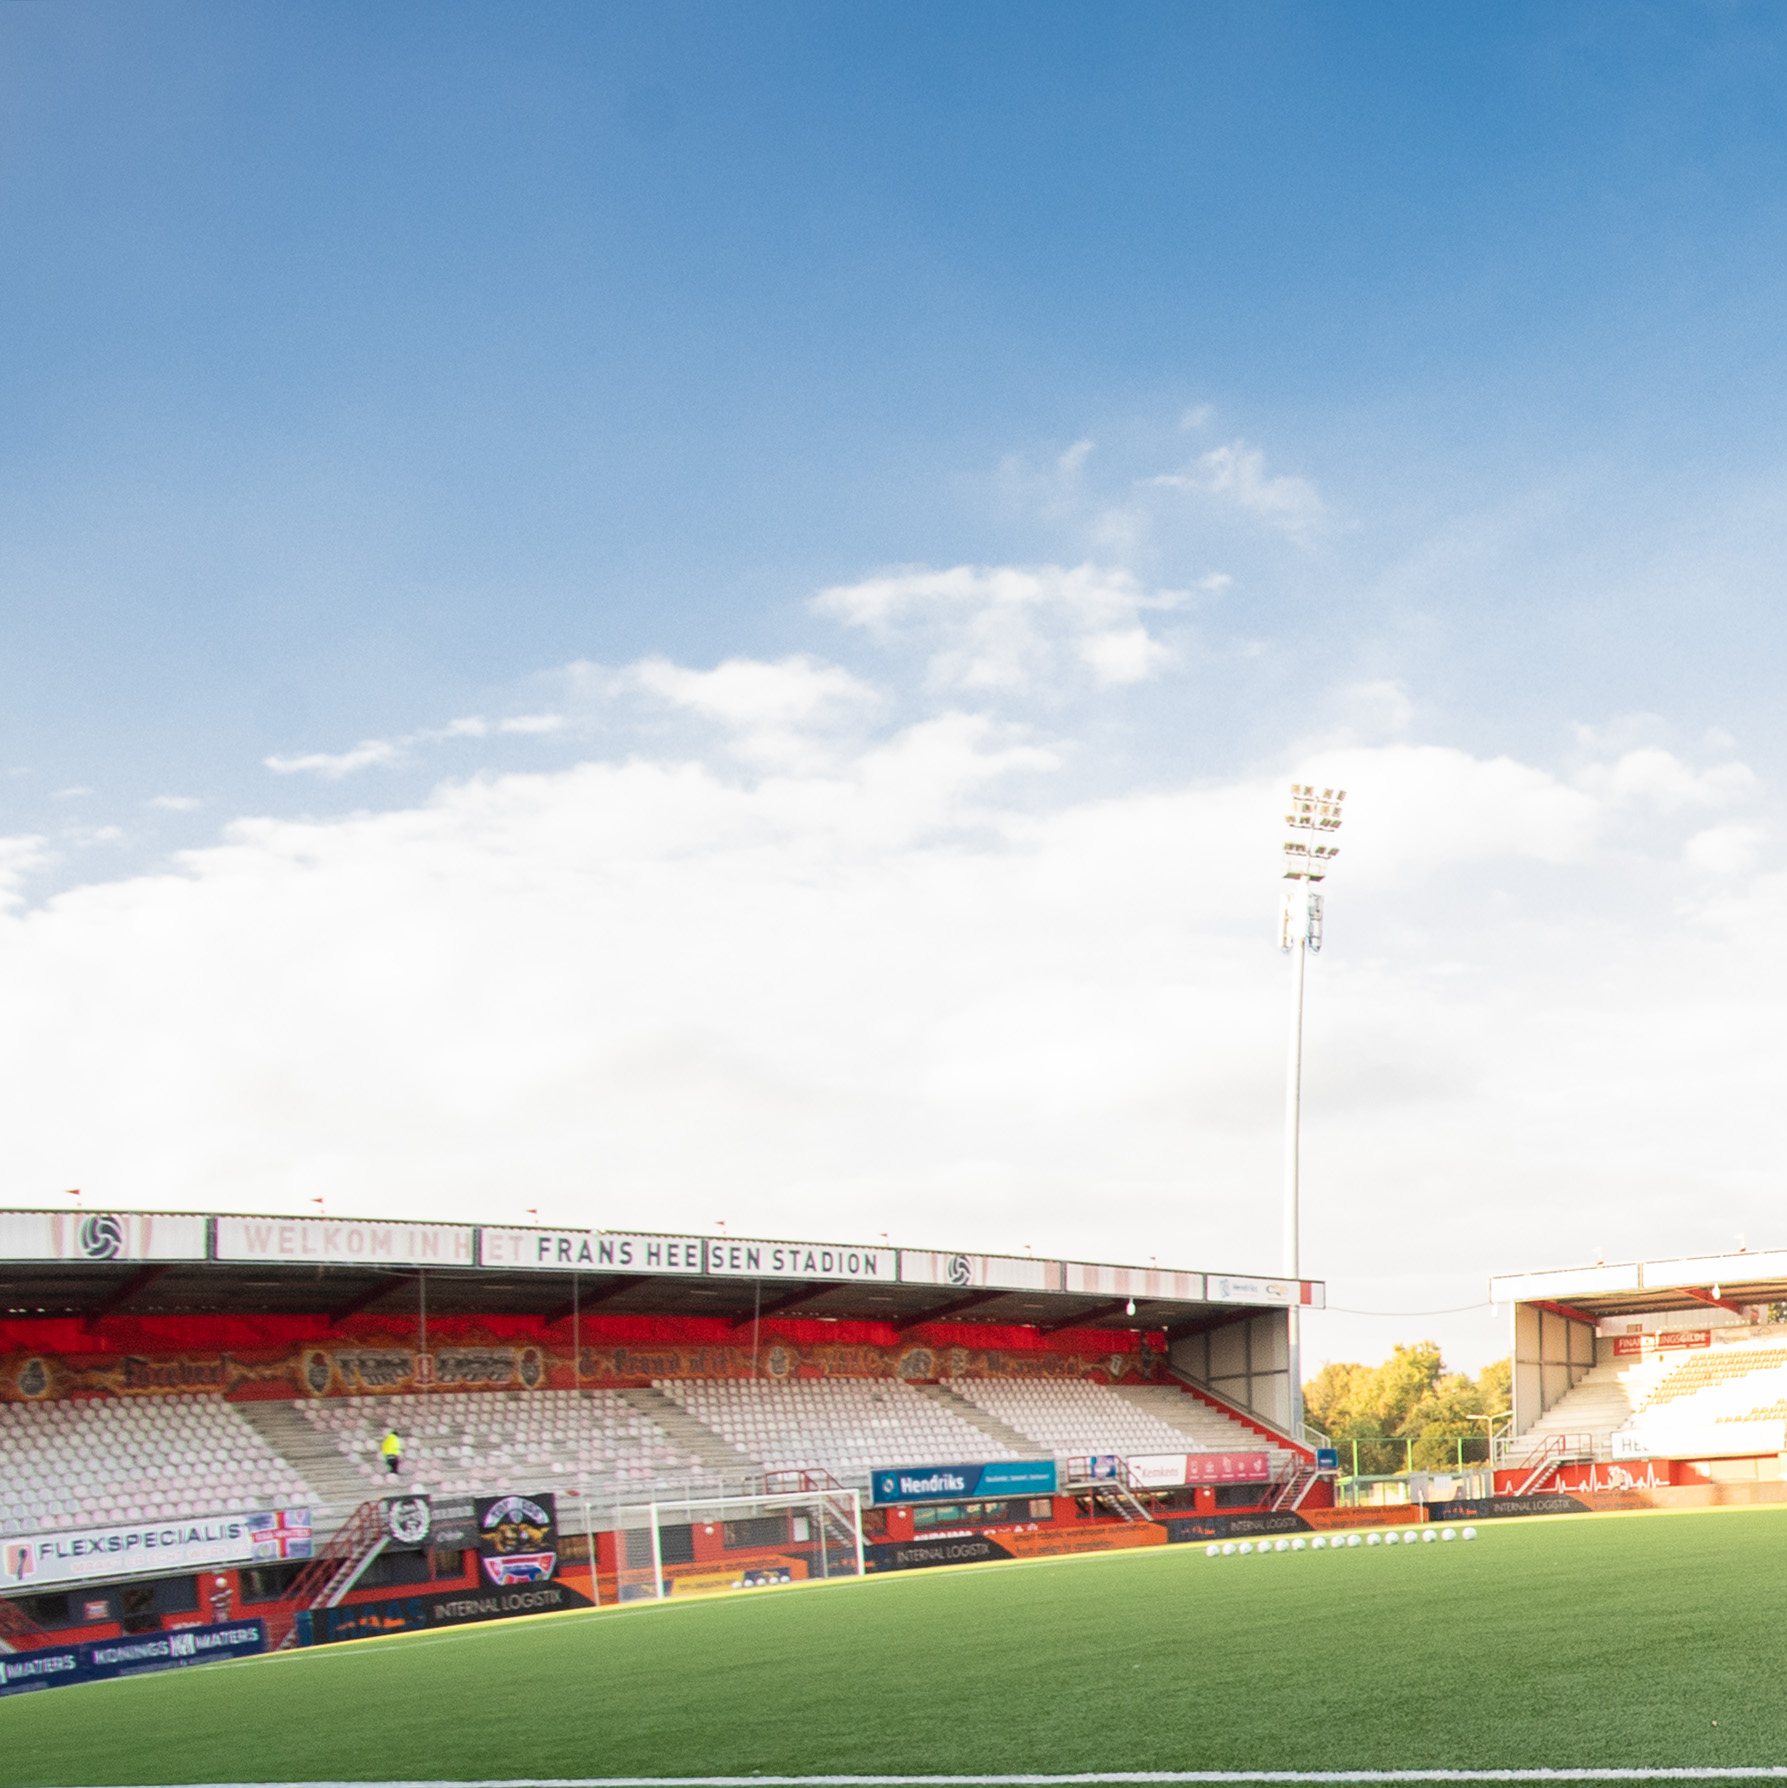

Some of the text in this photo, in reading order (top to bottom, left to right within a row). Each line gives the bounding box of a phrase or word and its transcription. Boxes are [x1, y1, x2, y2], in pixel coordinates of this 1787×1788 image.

[244, 1224, 394, 1257] WELKOM
[407, 1231, 440, 1258] IN
[454, 1235, 526, 1261] HET
[538, 1237, 634, 1265] FRANS
[772, 1248, 879, 1276] STADION
[901, 1474, 965, 1494] Hendriks
[897, 1547, 944, 1564] INTERNAL
[946, 1542, 991, 1559] LOGISTIX
[434, 1599, 502, 1621] INTERNAL
[502, 1589, 563, 1612] LOGISTIX
[92, 1641, 170, 1665] KONINGS
